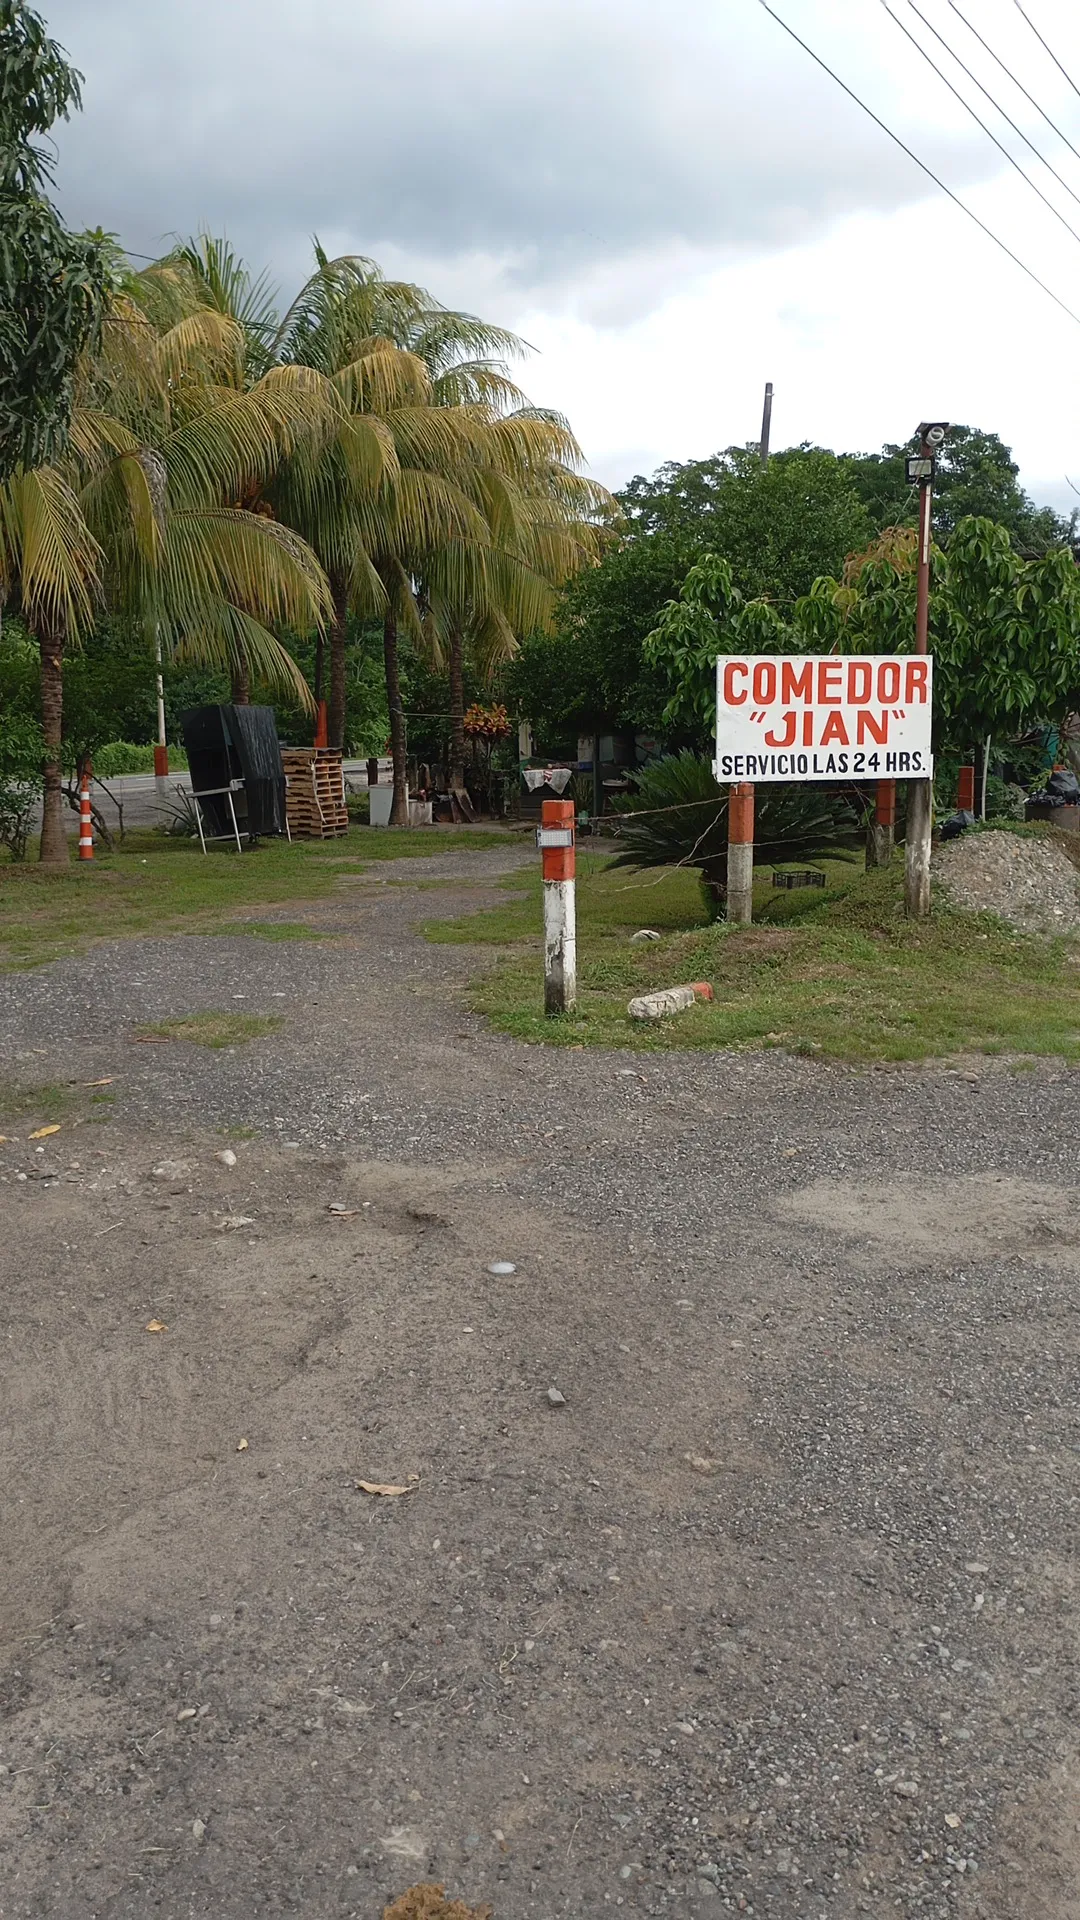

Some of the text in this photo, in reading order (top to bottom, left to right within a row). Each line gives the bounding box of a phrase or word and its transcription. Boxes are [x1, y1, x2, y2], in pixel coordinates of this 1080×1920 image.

[723, 661, 928, 705] COMEDOR
[750, 709, 906, 747] "JIAN"
[721, 751, 926, 776] SERVICIO LAS 24 HRS.
